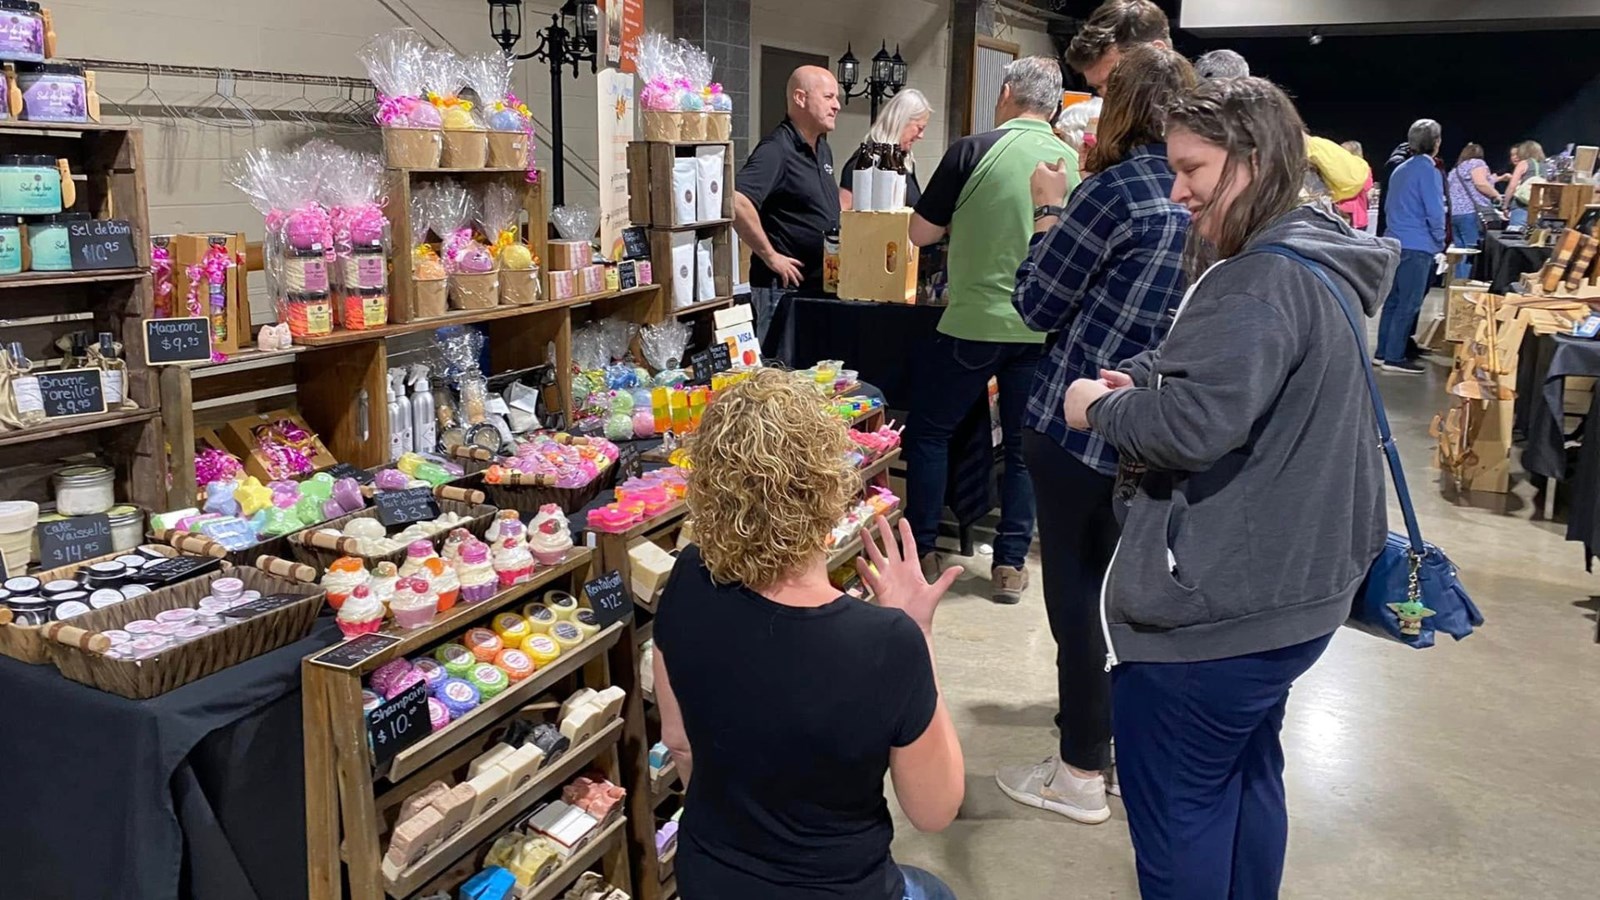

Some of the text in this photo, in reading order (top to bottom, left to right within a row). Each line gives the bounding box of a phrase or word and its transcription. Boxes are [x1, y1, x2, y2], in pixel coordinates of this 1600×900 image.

[19, 183, 32, 192] Sel
[149, 322, 203, 336] Macaron
[737, 332, 753, 343] VISA
[39, 375, 88, 389] Brume
[371, 683, 427, 725] Shampoing
